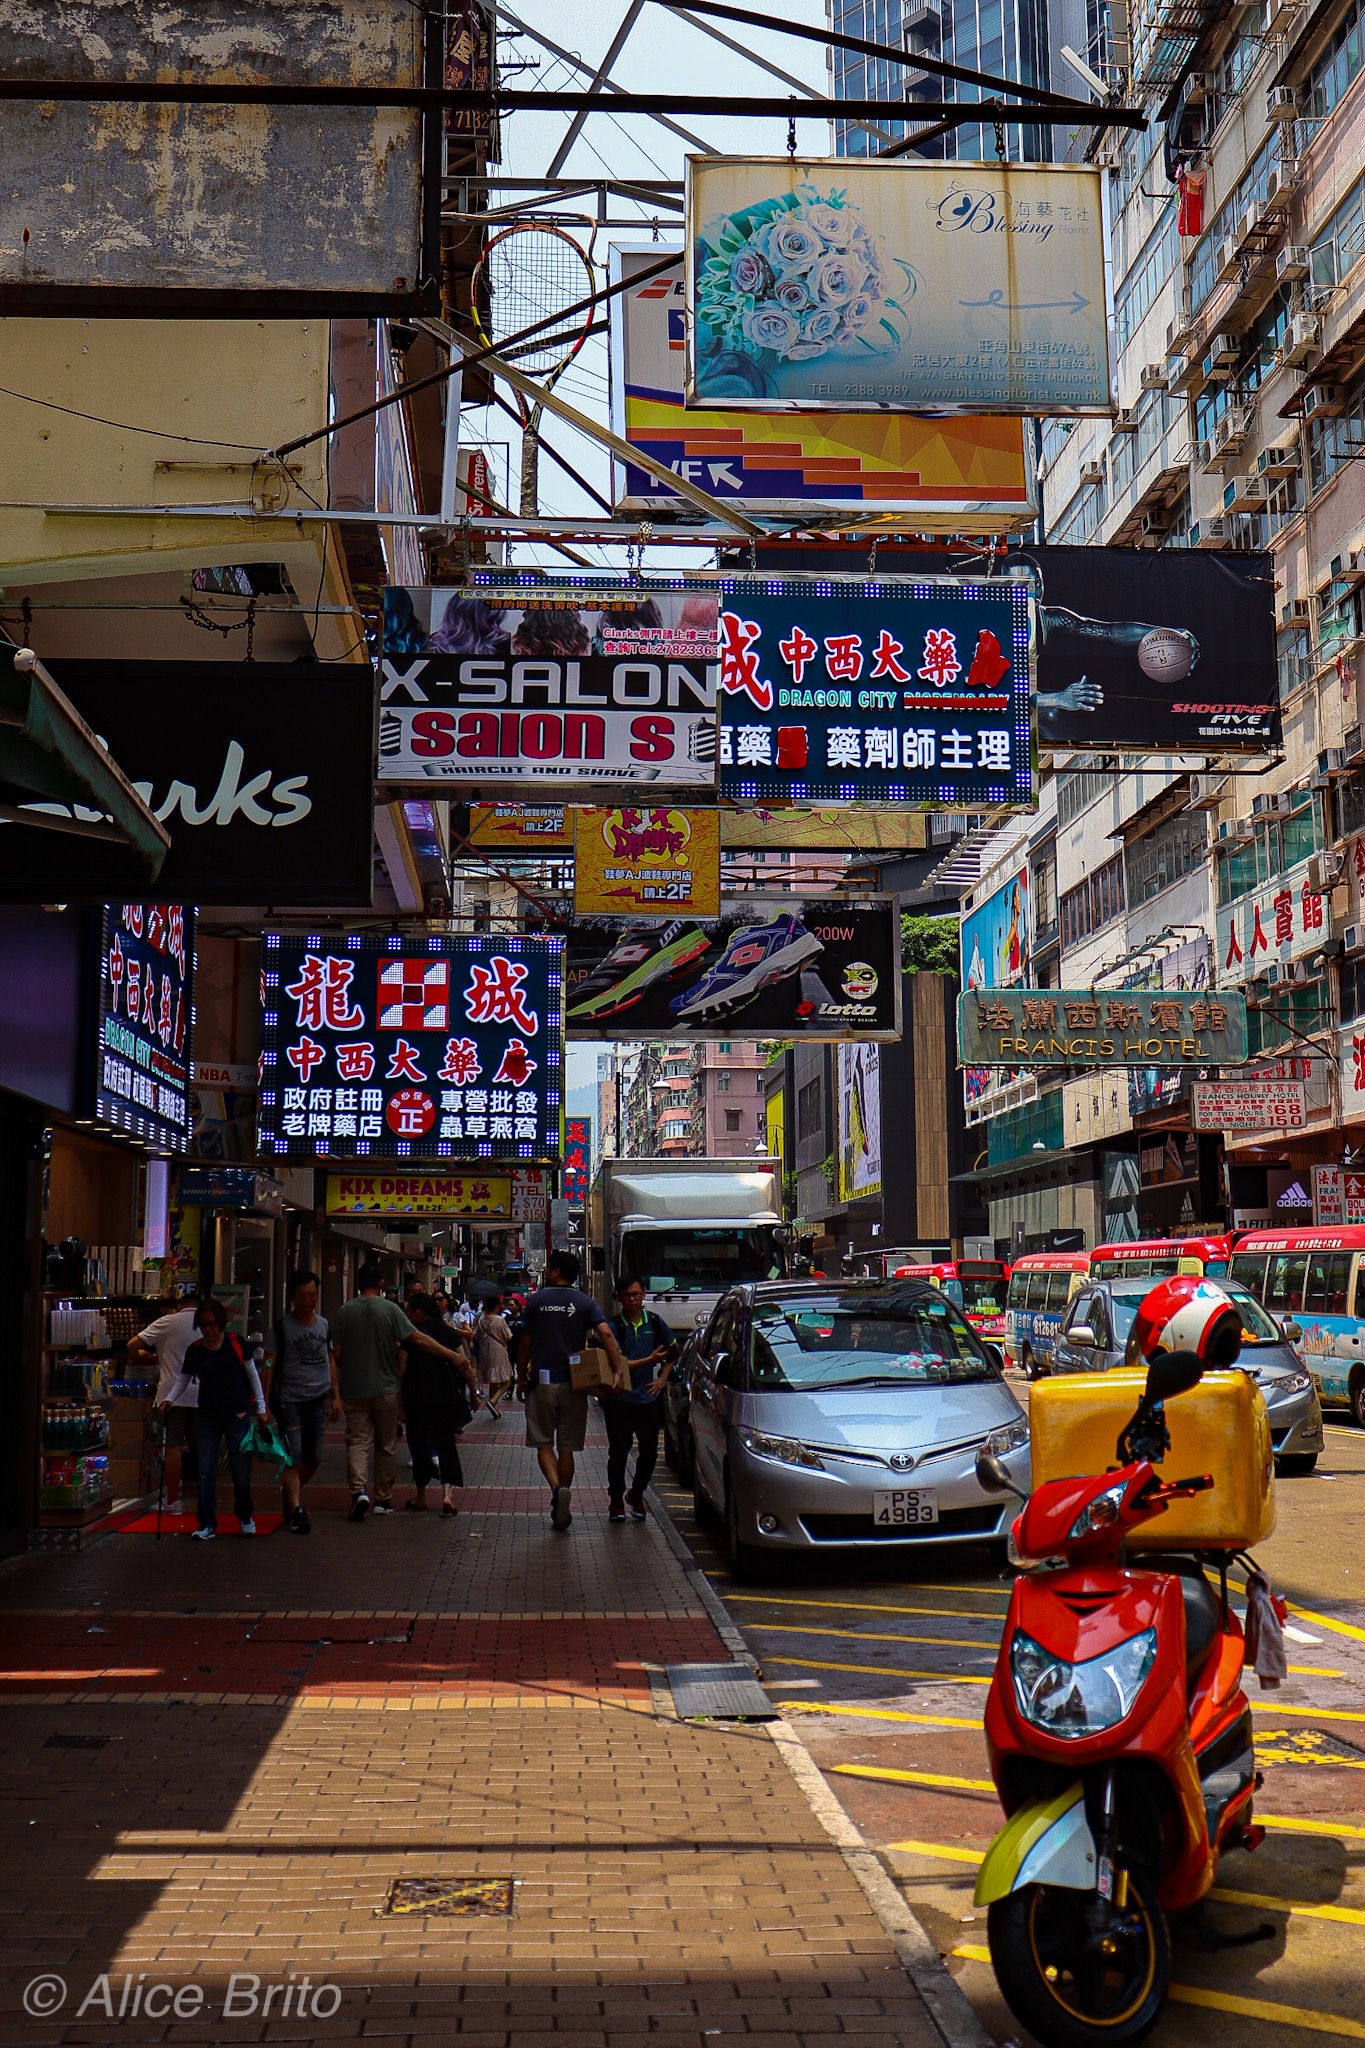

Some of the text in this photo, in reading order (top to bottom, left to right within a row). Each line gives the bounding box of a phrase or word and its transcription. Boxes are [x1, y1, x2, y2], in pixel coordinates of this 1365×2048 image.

[1058, 225, 1090, 235] Florist
[944, 371, 973, 381] SHAN
[976, 372, 1003, 381] TUNG
[1050, 373, 1100, 383] MONGKOK
[810, 383, 1101, 401] TEL: 2388 3989 www.blessingflorist.com.hk
[468, 453, 486, 517] Sureme
[778, 626, 1011, 688] 中西大藥
[380, 658, 717, 708] X-SALON
[779, 688, 851, 708] DRAGON
[858, 690, 898, 709] CITY
[1171, 703, 1268, 714] SHOOTING
[1210, 714, 1262, 725] FIVE
[410, 711, 605, 760] salon
[826, 725, 1012, 771] 藥劑師主理
[441, 765, 641, 778] HAIRCUT AND SHAVE
[643, 883, 692, 900] 請上2F
[814, 926, 854, 941] 200W
[109, 932, 186, 1058] 中西大藥
[285, 954, 539, 1036] 龍 城
[818, 1002, 877, 1016] lotto
[977, 998, 1228, 1032] 法蘭西斯賓館
[998, 1037, 1210, 1057] FRANCIS HOTEL
[199, 1068, 257, 1082] NBA T-sh
[283, 1087, 539, 1115] 政府註冊 專營批發
[1267, 1104, 1301, 1115] $68
[282, 1113, 538, 1140] 老牌藥店 蟲草燕窩
[397, 1108, 423, 1133] 正
[1260, 1115, 1303, 1126] $150
[340, 1178, 375, 1196] KIX
[380, 1179, 464, 1197] DREAMS
[523, 1197, 545, 1209] $70
[1276, 1197, 1313, 1208] adidas
[522, 1209, 546, 1221] $150
[545, 1305, 566, 1313] LOGIC
[892, 1491, 920, 1508] PS
[878, 1505, 933, 1524] 4983
